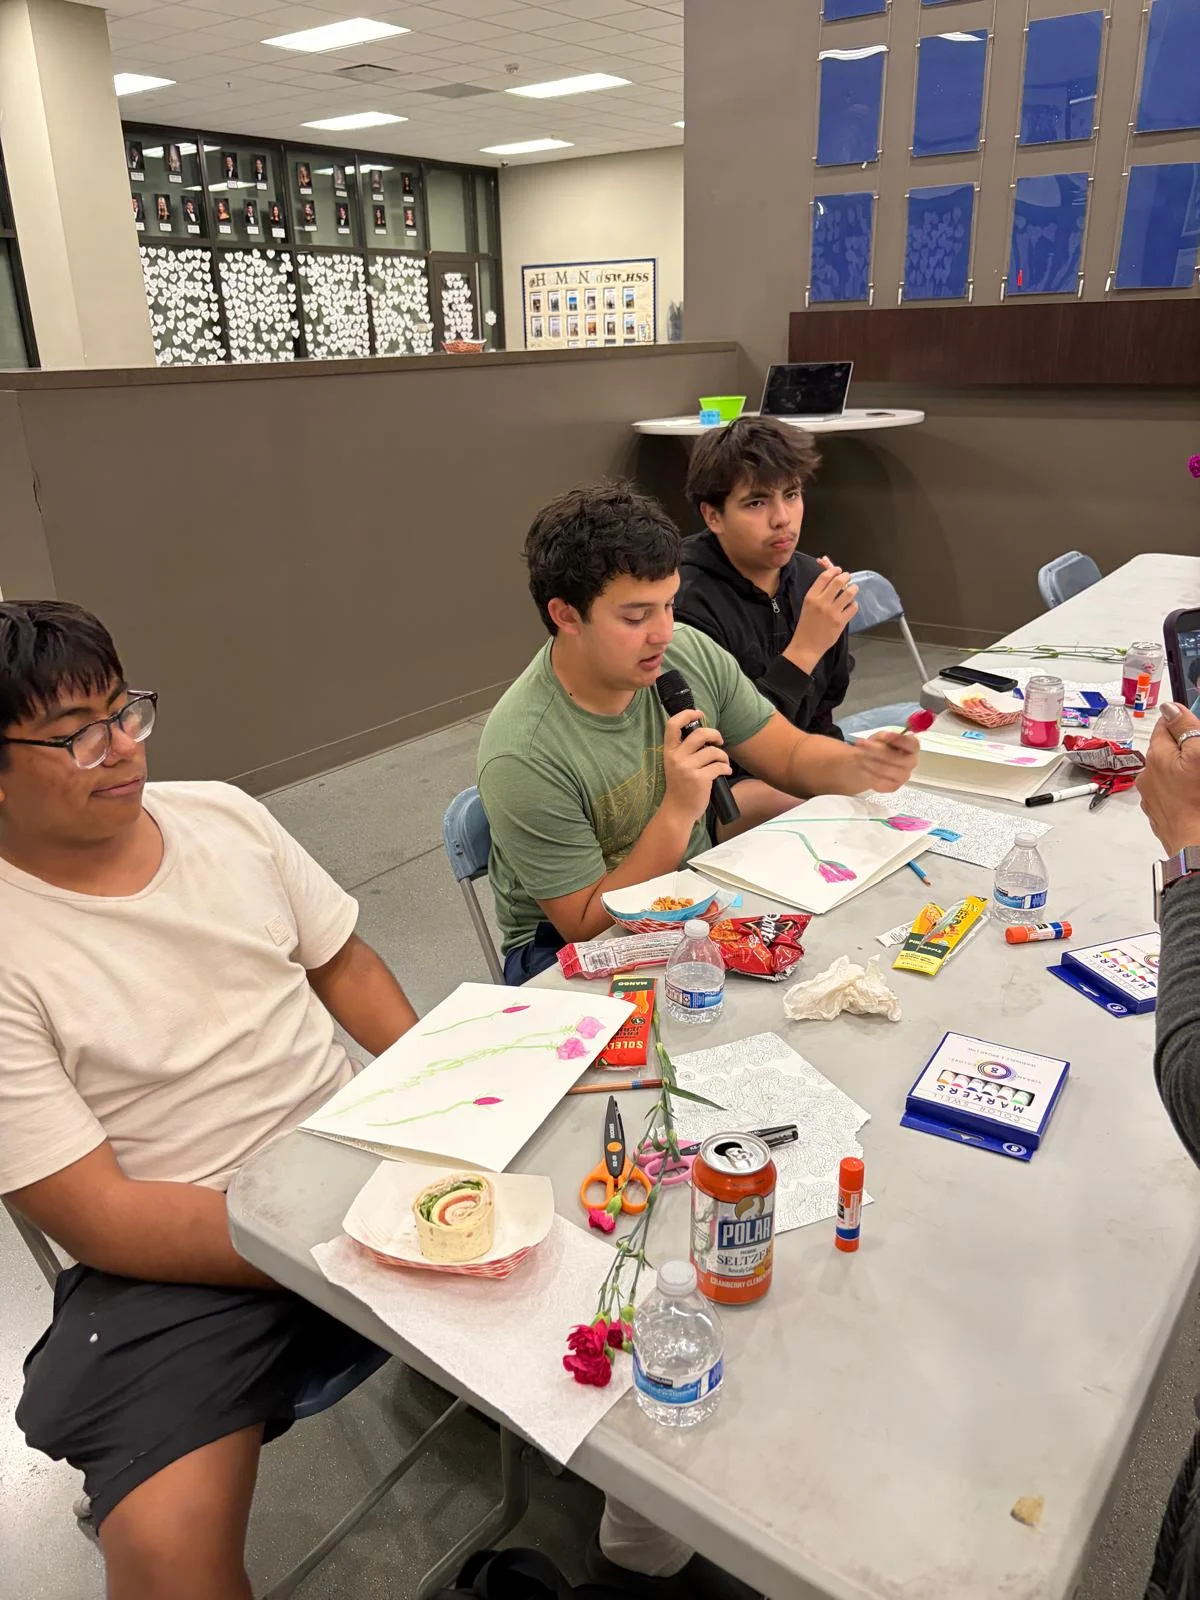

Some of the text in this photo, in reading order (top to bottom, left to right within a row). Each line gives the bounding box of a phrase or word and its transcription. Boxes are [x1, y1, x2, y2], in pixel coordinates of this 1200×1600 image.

[1093, 953, 1149, 989] MARKERS
[937, 1084, 1025, 1114] MARKERS
[722, 1216, 771, 1246] POLAR
[710, 1276, 745, 1289] CRANBERRY
